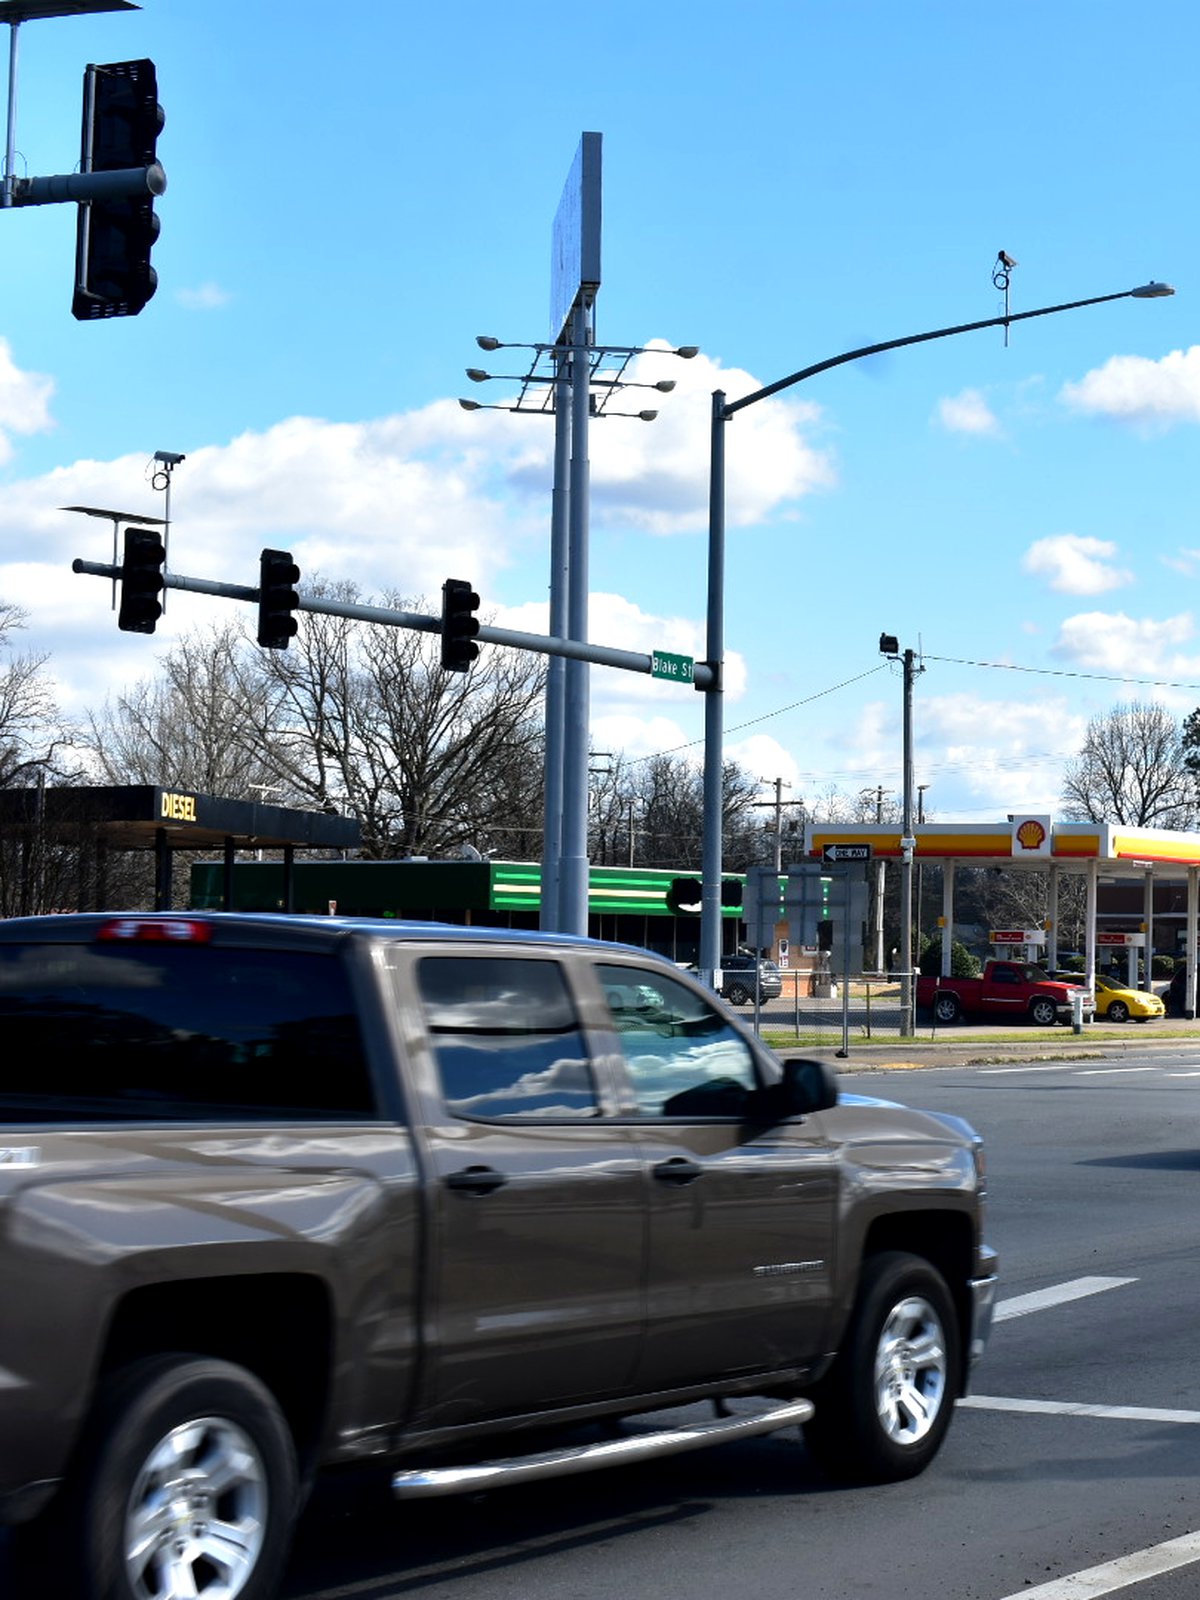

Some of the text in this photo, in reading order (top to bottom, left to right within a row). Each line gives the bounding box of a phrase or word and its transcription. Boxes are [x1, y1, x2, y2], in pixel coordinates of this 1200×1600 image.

[653, 657, 692, 677] Blake St
[161, 792, 197, 822] DIESEL
